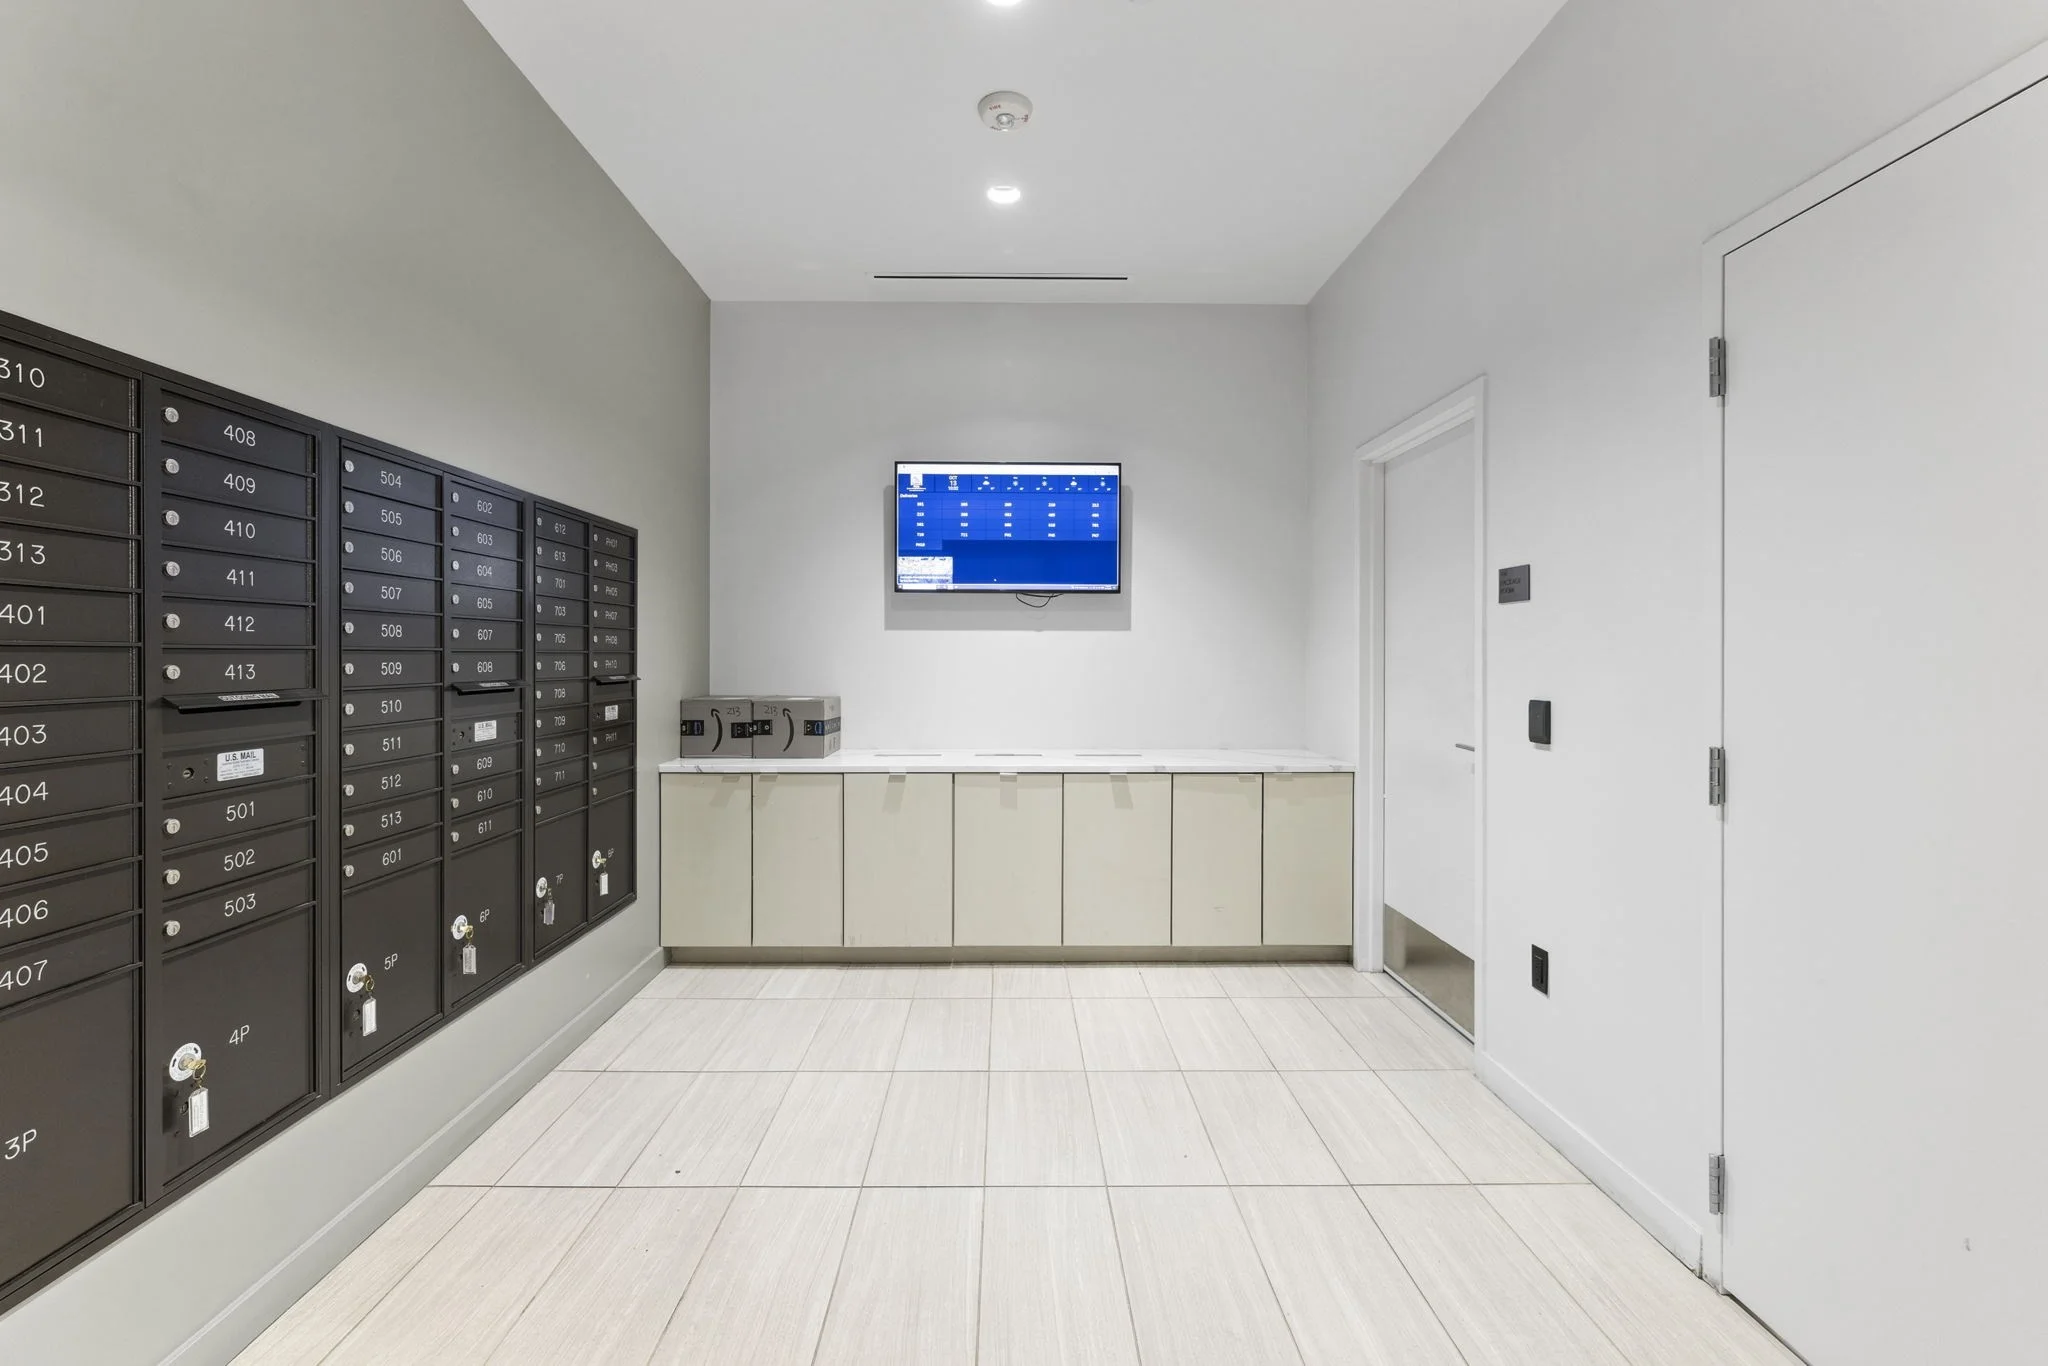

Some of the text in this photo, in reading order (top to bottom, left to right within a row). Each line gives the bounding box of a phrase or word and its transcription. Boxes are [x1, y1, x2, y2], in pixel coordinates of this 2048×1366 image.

[0, 358, 44, 388] 310
[0, 420, 41, 447] 311
[224, 425, 255, 446] 408
[224, 474, 255, 493] 409
[381, 471, 401, 488] 504
[0, 481, 44, 507] 312
[477, 500, 492, 514] 602
[381, 509, 402, 525] 505
[224, 520, 255, 538] 410
[554, 524, 566, 534] 612
[478, 533, 492, 545] 603
[0, 541, 45, 564] 313
[381, 548, 402, 562] 506
[554, 551, 566, 561] 613
[227, 569, 253, 586] 411
[477, 565, 492, 576] 604
[554, 578, 566, 588] 701
[381, 586, 401, 599] 507
[477, 598, 492, 609] 605
[554, 606, 566, 616] 703
[0, 604, 43, 625] 401
[225, 616, 254, 631] 412
[382, 624, 402, 637] 508
[478, 629, 492, 640] 607
[0, 664, 47, 683] 402
[225, 664, 255, 680] 413
[381, 662, 402, 675] 509
[478, 662, 492, 672] 608
[381, 700, 401, 713] 510
[0, 725, 46, 746] 403
[383, 737, 400, 751] 511
[553, 743, 566, 752] 710
[225, 751, 257, 762] U.S. MAIL
[477, 757, 492, 769] 609
[382, 774, 401, 789] 512
[554, 771, 565, 781] 711
[0, 782, 48, 806] 404
[478, 788, 492, 801] 610
[226, 801, 254, 821] 501
[382, 811, 401, 827] 513
[479, 820, 491, 833] 611
[0, 842, 48, 868] 405
[224, 849, 255, 871] 502
[383, 849, 401, 865] 601
[225, 893, 255, 916] 503
[0, 900, 48, 928] 406
[480, 909, 489, 922] 6P
[385, 953, 398, 970] 5P
[0, 960, 47, 990] 407
[229, 1025, 249, 1044] 4P
[5, 1129, 36, 1159] 3P
